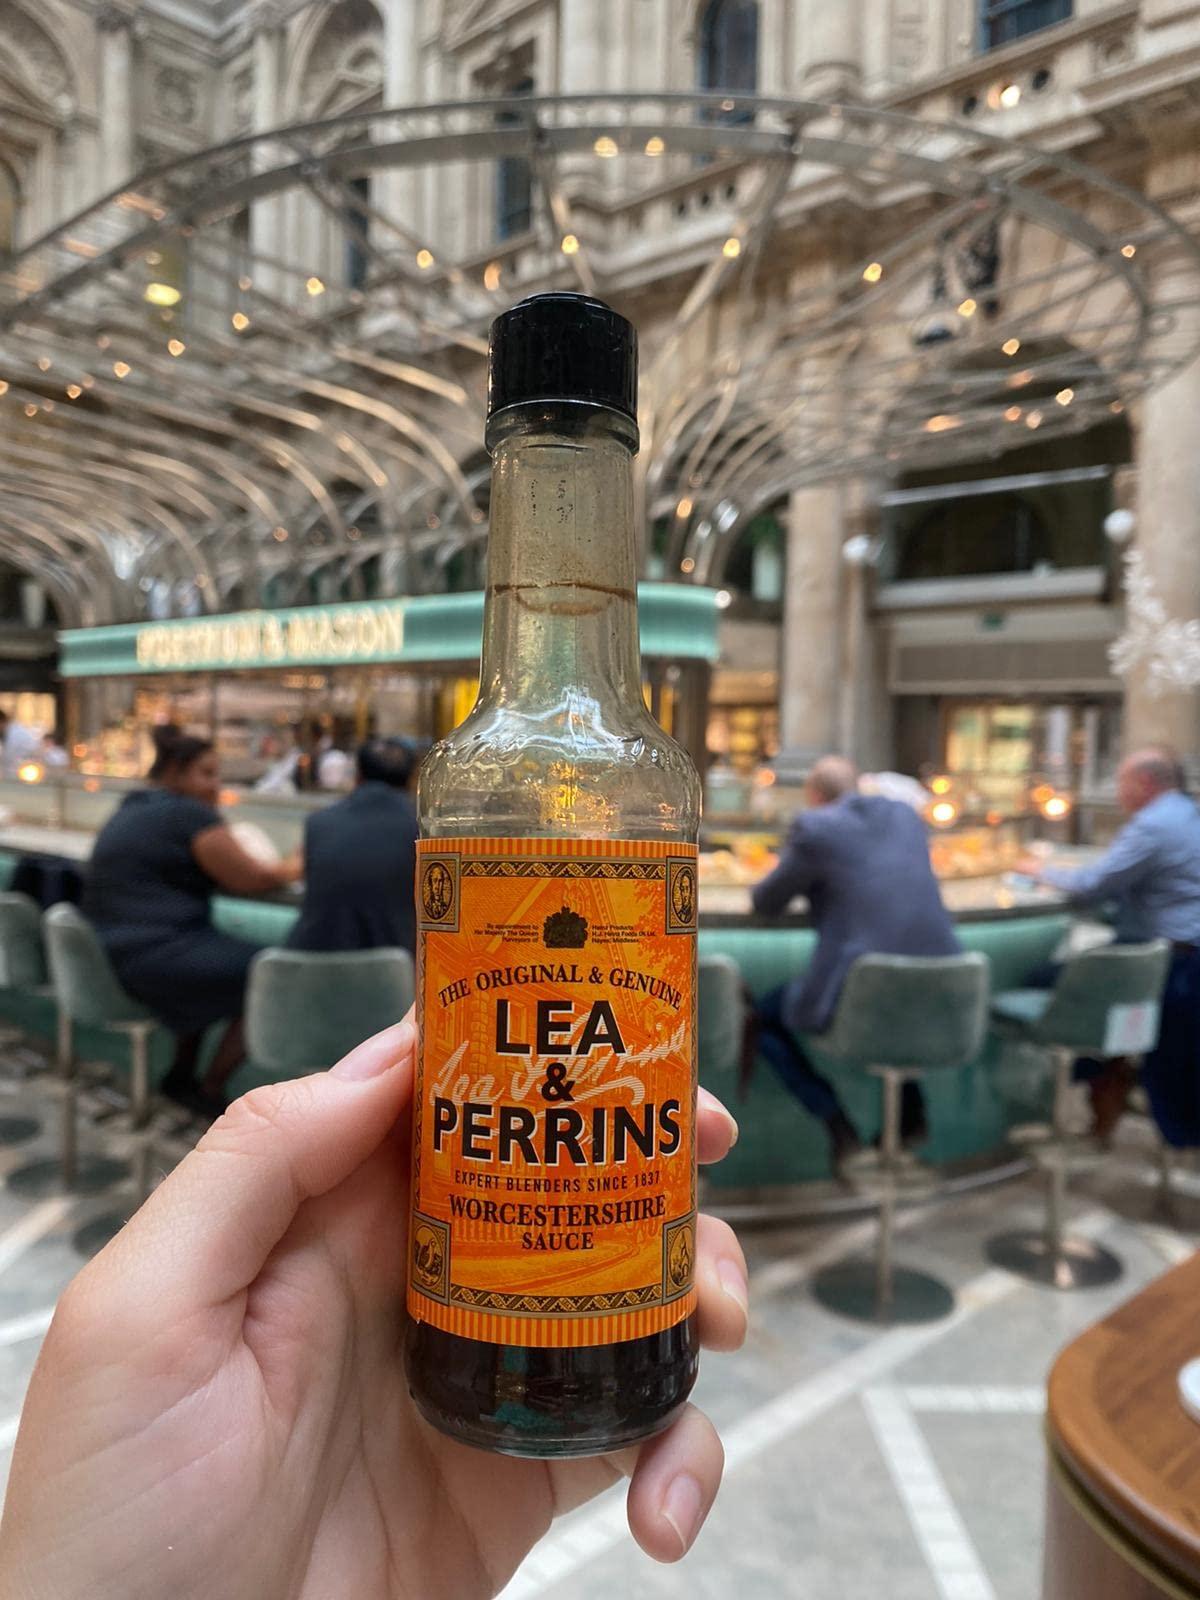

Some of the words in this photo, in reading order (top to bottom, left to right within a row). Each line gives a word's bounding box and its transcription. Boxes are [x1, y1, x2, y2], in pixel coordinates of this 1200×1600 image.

[438, 978, 471, 1008] THE
[476, 964, 583, 992] ORIGINAL
[589, 967, 603, 984] &
[609, 968, 682, 1011] GENUINE
[496, 998, 627, 1057] LEA
[541, 1062, 575, 1102] &
[433, 1097, 682, 1167] PERRINS
[455, 1170, 500, 1190] EXPERT
[506, 1177, 581, 1193] BLENDERS
[588, 1175, 628, 1192] SINCE
[633, 1170, 661, 1188] 1837
[448, 1193, 666, 1227] WORCESTERSHIRE
[521, 1231, 594, 1251] SAUCE
